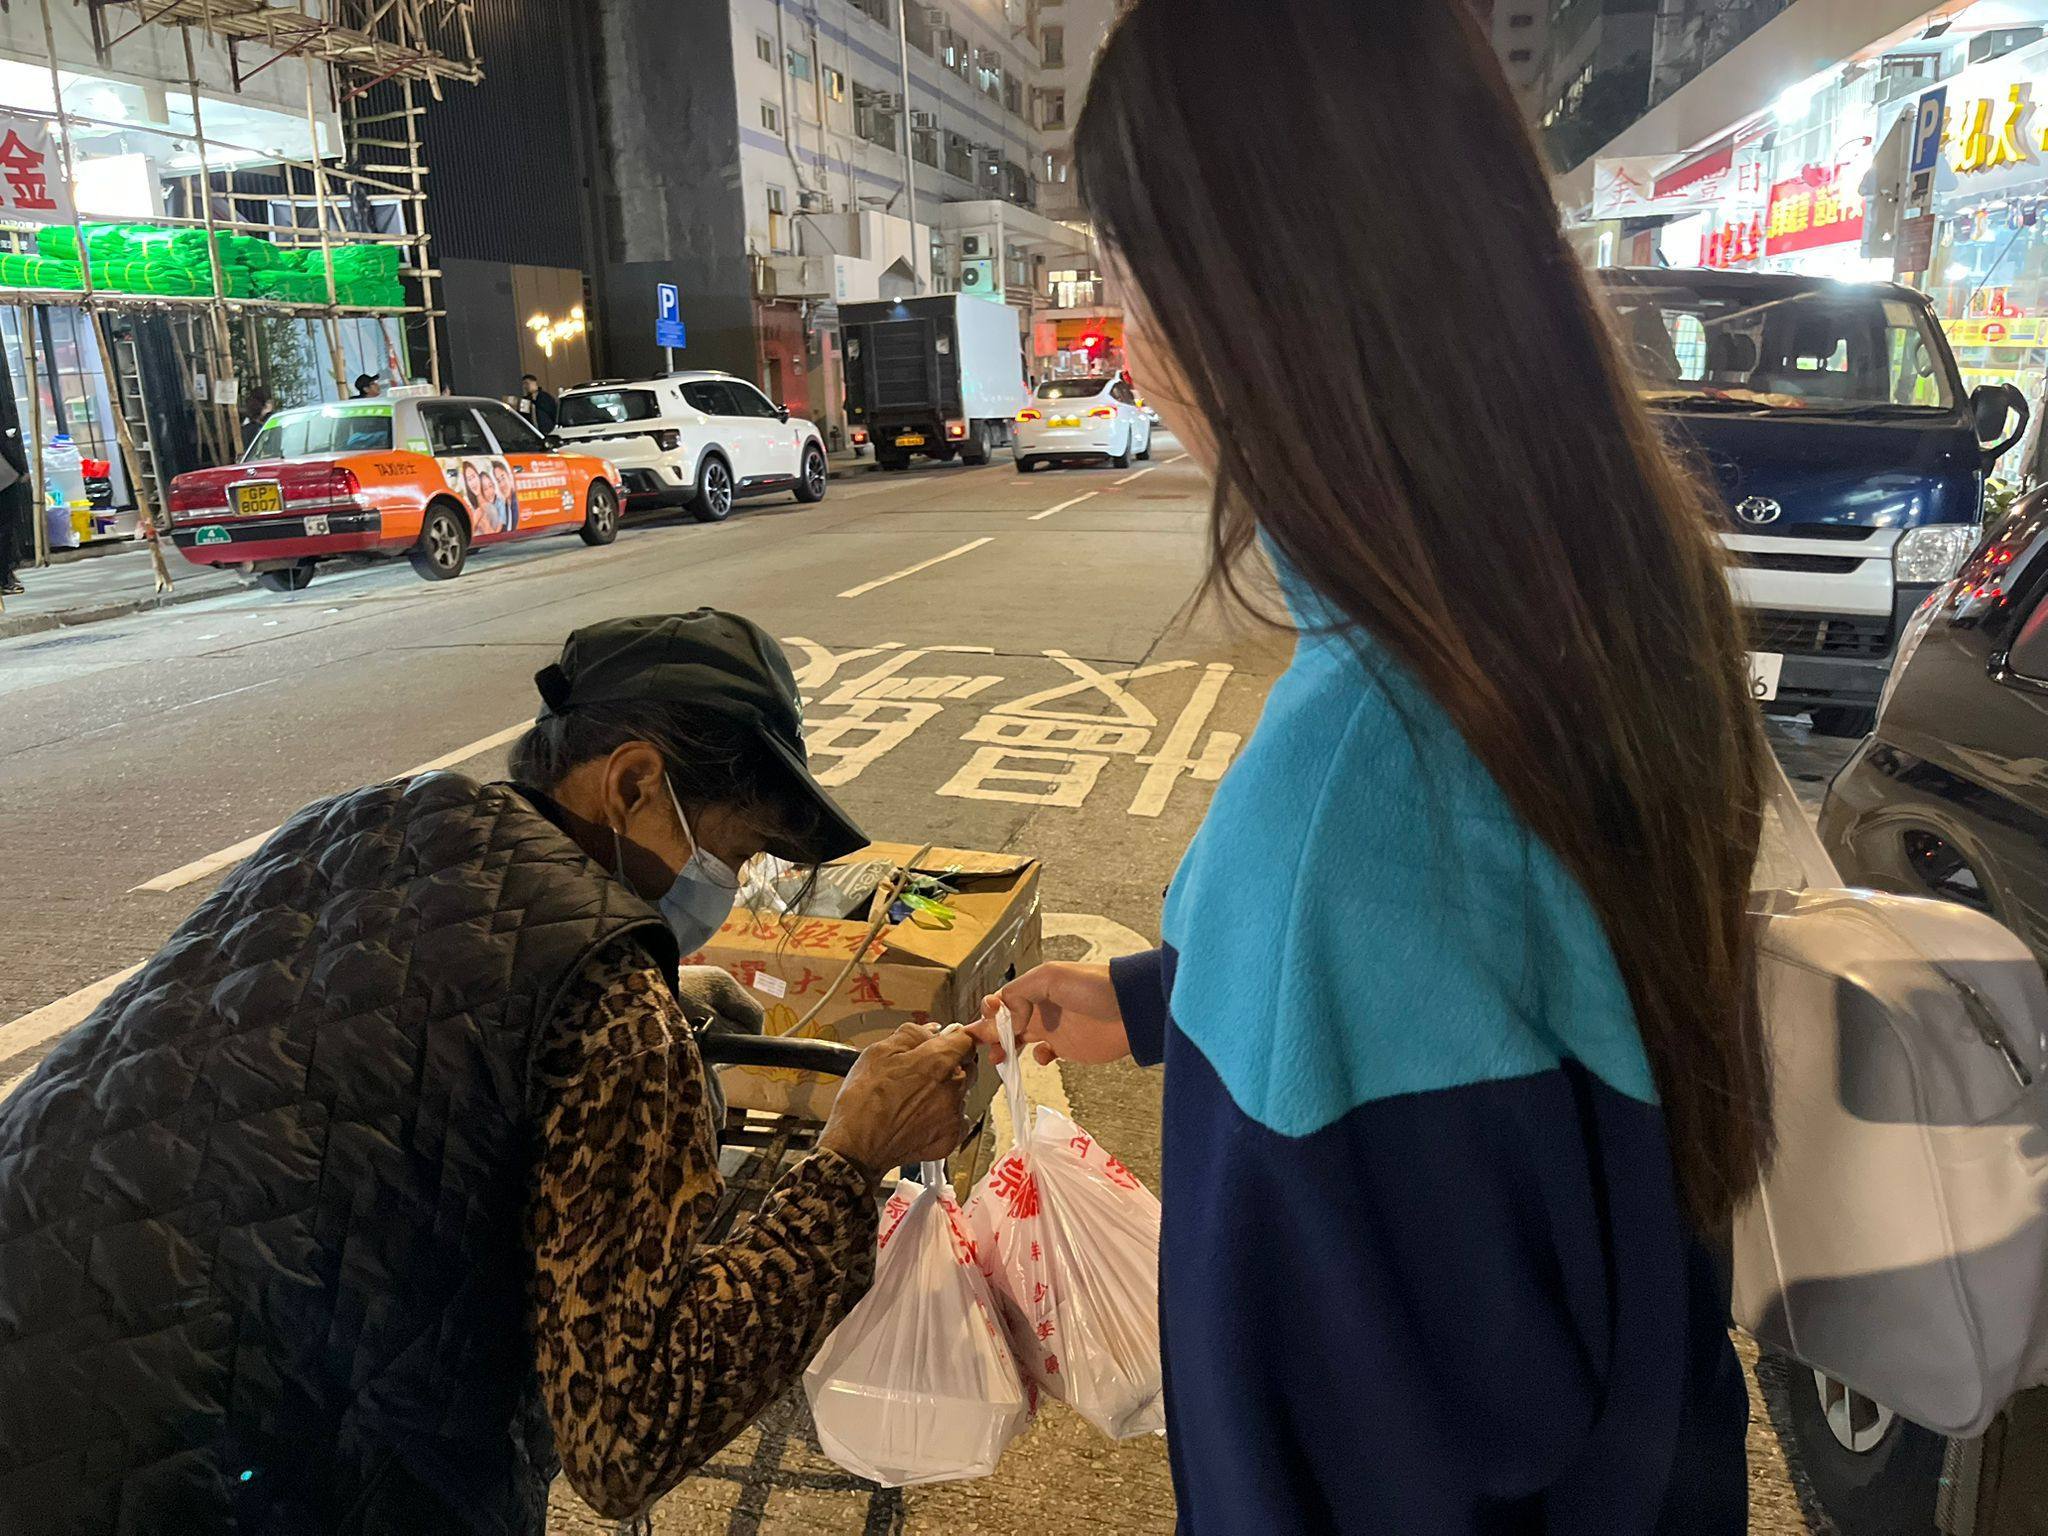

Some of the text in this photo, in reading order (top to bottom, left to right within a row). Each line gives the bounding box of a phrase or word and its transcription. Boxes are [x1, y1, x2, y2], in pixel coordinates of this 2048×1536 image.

[1916, 99, 1939, 165] P
[0, 128, 57, 210] 金
[661, 287, 675, 319] P
[242, 499, 276, 512] 8007
[249, 487, 267, 499] GP
